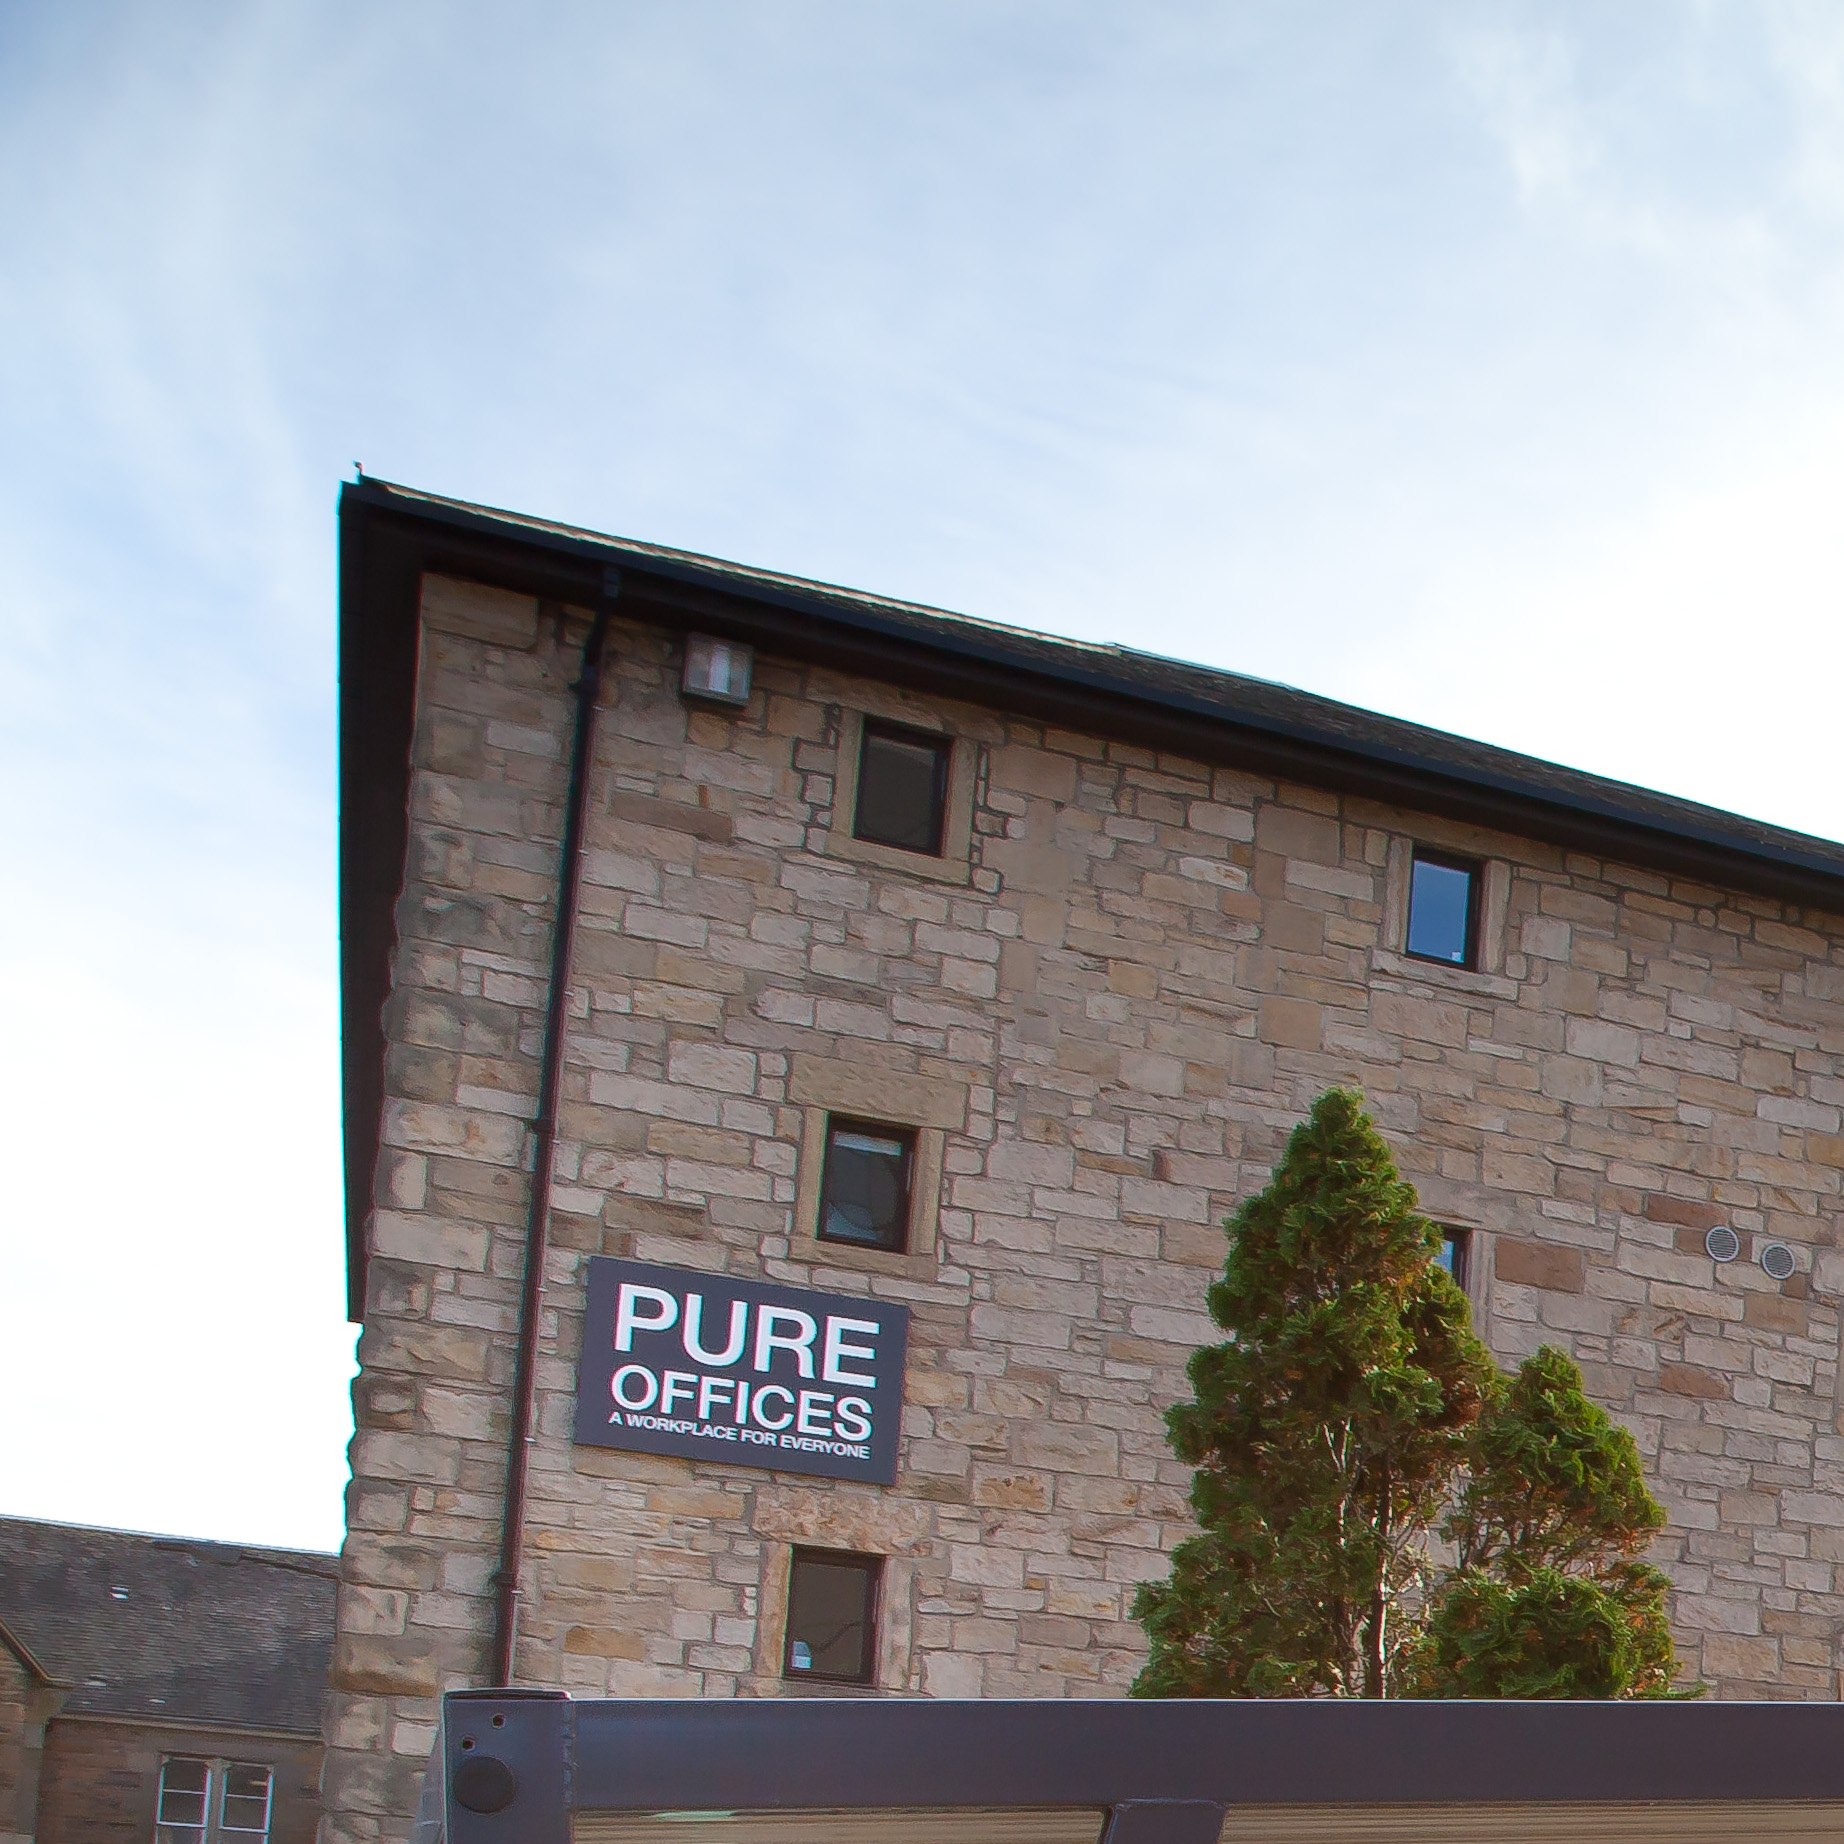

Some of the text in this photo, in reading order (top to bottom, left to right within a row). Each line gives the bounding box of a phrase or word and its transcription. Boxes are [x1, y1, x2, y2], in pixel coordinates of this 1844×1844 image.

[613, 1282, 880, 1389] PURE
[607, 1410, 871, 1460] A WORKPLACE FOR EVERYONE
[610, 1363, 873, 1442] OFFICES
